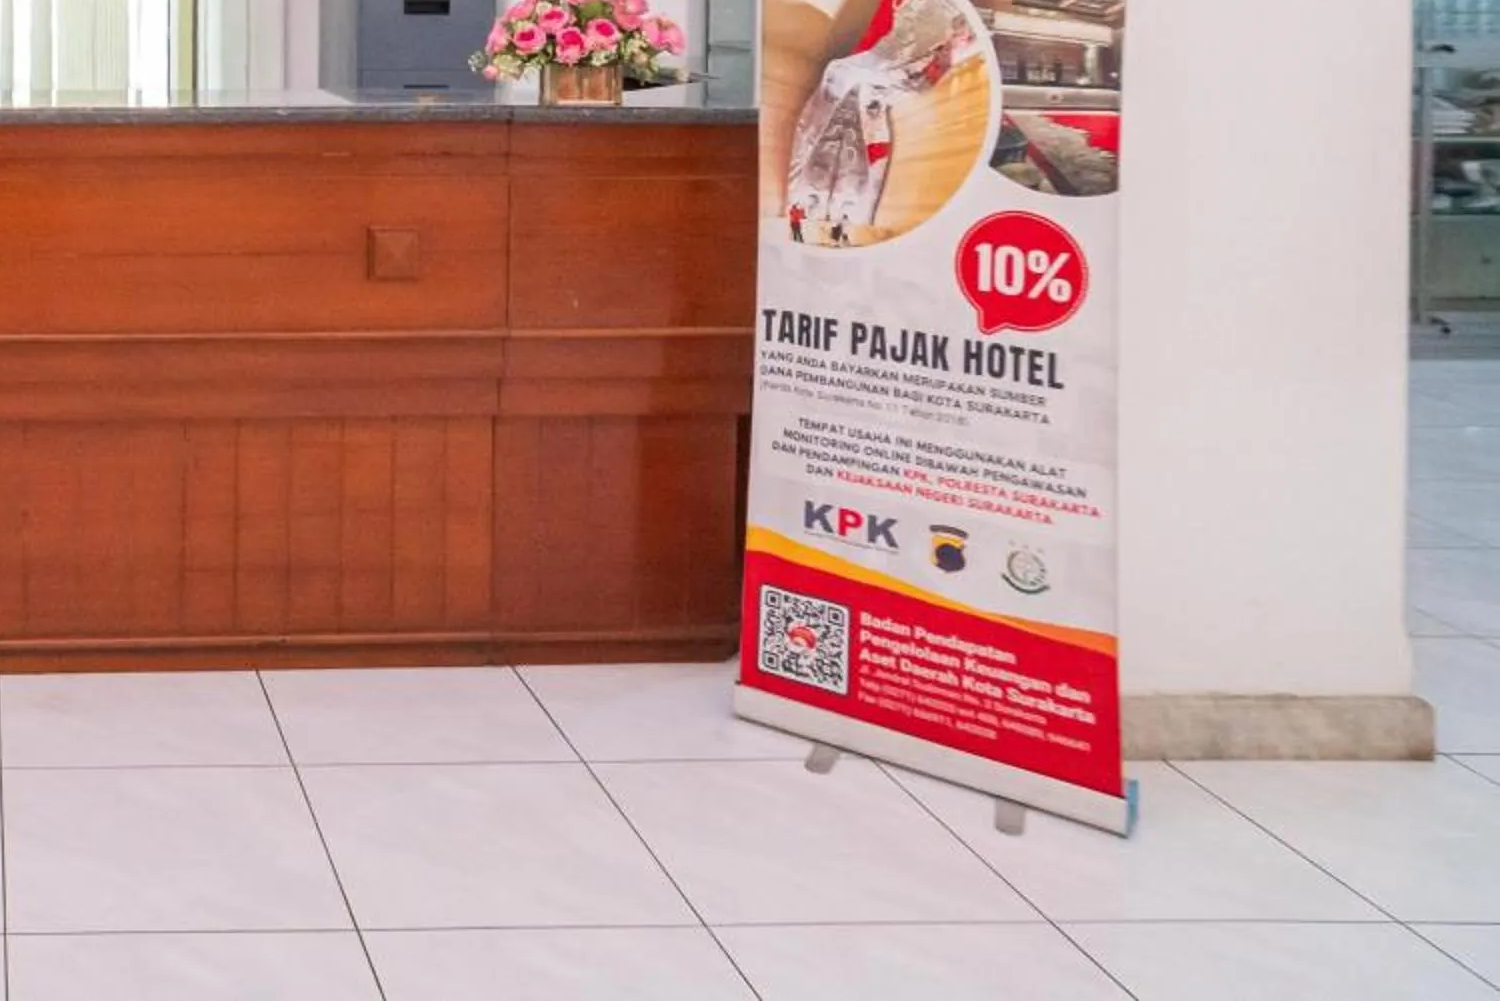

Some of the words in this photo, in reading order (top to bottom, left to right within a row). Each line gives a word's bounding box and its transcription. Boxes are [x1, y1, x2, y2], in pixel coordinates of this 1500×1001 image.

[974, 242, 1072, 303] 10%
[761, 350, 793, 363] YANG
[796, 355, 826, 369] ANDA
[831, 360, 898, 381] BAYARKAN
[902, 372, 986, 396] MERUPAKAN
[989, 387, 1046, 407] SUMBER
[763, 309, 838, 351] TARIF
[851, 321, 949, 371] PAJAK
[964, 339, 1065, 389] HOTEL
[761, 365, 793, 378] DANA
[796, 370, 889, 396] PEMBANGUNAN
[893, 386, 924, 402] BAGI
[927, 395, 962, 409] KOTA
[966, 400, 1051, 425] SURAKARTA
[771, 440, 797, 454] DAN
[799, 446, 900, 476] PENDAMPINGAN
[1012, 490, 1101, 517] SURAKARTA
[783, 427, 860, 454] MONITORING
[863, 446, 911, 464] ONLINE
[915, 455, 978, 477] DIBAWAH
[983, 467, 1087, 498] PENGAWASAN
[799, 417, 845, 435] TEMPAT
[848, 427, 891, 444] USAHA
[896, 436, 912, 448] INI
[916, 440, 1027, 472] MENGGUNAKAN
[1030, 463, 1067, 479] ALAT
[804, 500, 900, 549] KPK
[805, 463, 834, 477] DAN
[836, 469, 913, 495] KEJAKSAAN
[915, 485, 963, 505] NEGERI
[967, 497, 1054, 525] SURAKARTA
[860, 611, 911, 636] Badan
[914, 626, 1017, 665] Pendapatan
[860, 629, 960, 668] Pengelolaan
[1055, 683, 1092, 704] dan
[860, 648, 896, 670] Aset
[900, 658, 959, 687] Daerah
[962, 675, 1003, 699] Kota
[1006, 687, 1097, 726] Surakarta
